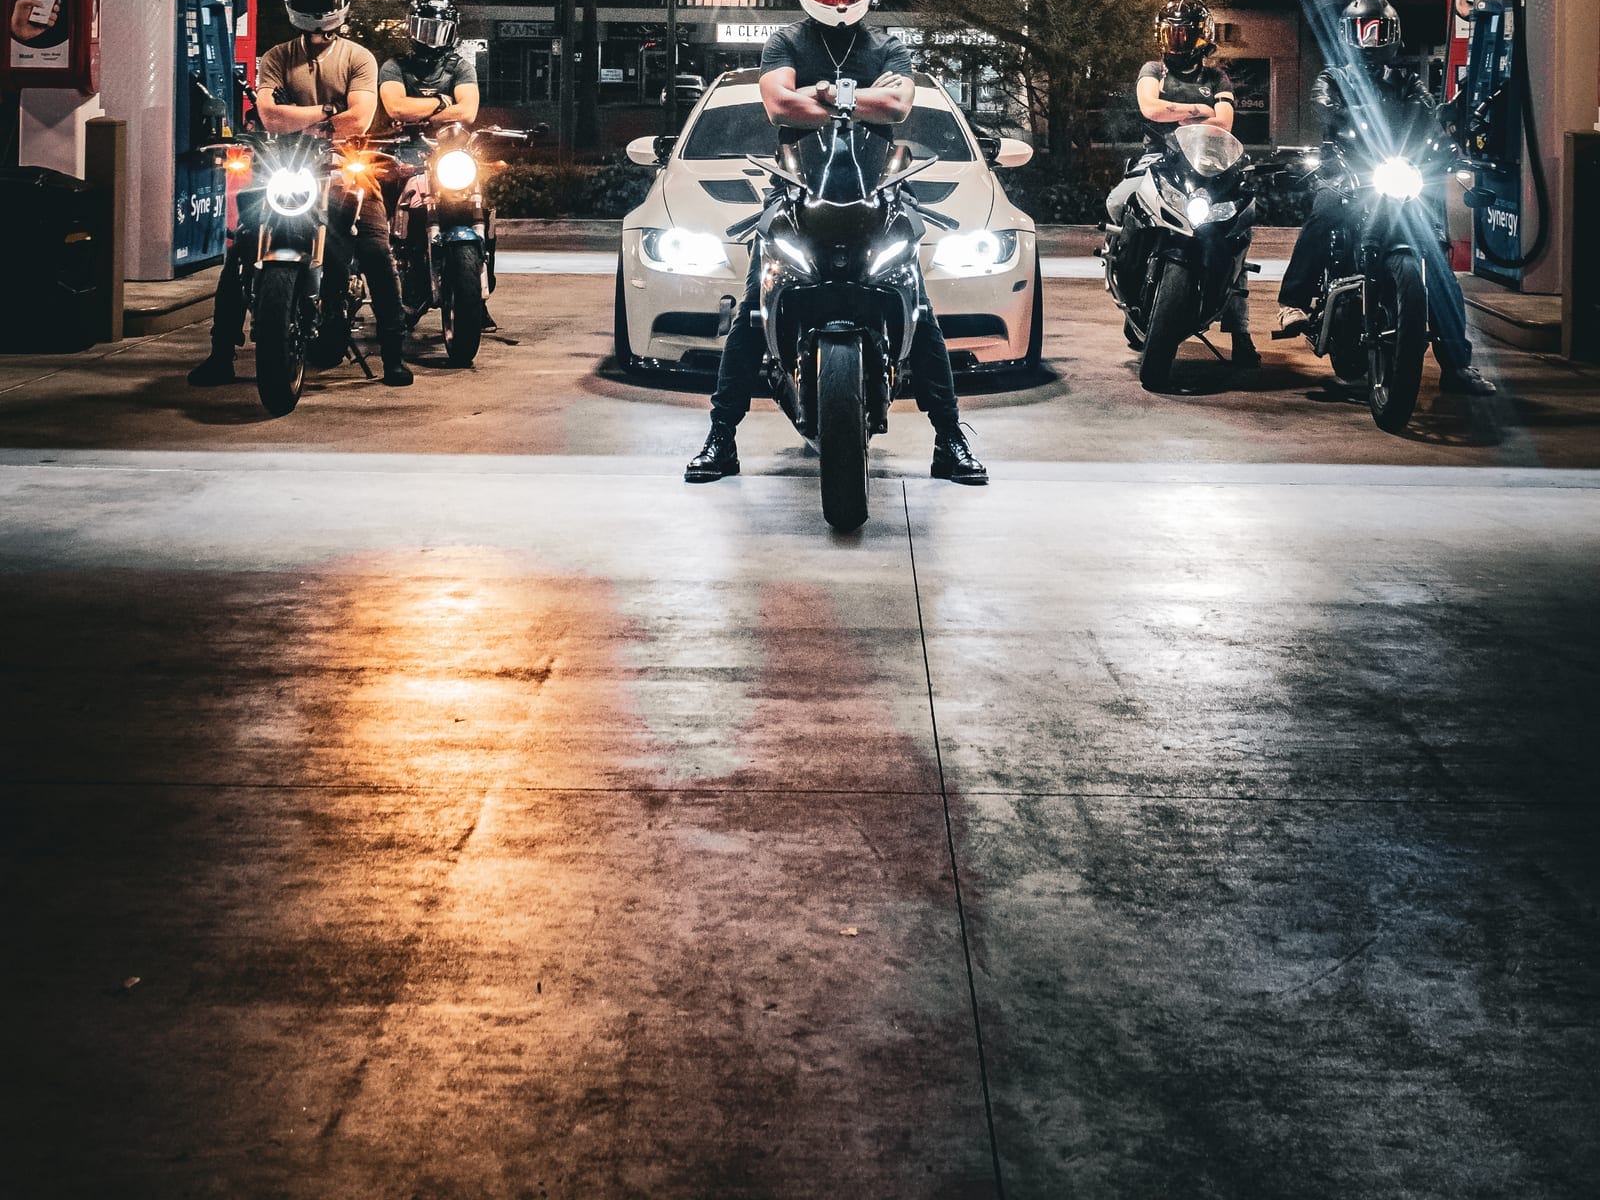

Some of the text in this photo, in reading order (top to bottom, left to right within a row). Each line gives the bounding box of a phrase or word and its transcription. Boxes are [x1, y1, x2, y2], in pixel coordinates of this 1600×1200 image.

[725, 25, 732, 37] A
[190, 193, 224, 223] Synegy
[1487, 206, 1518, 237] Synergy
